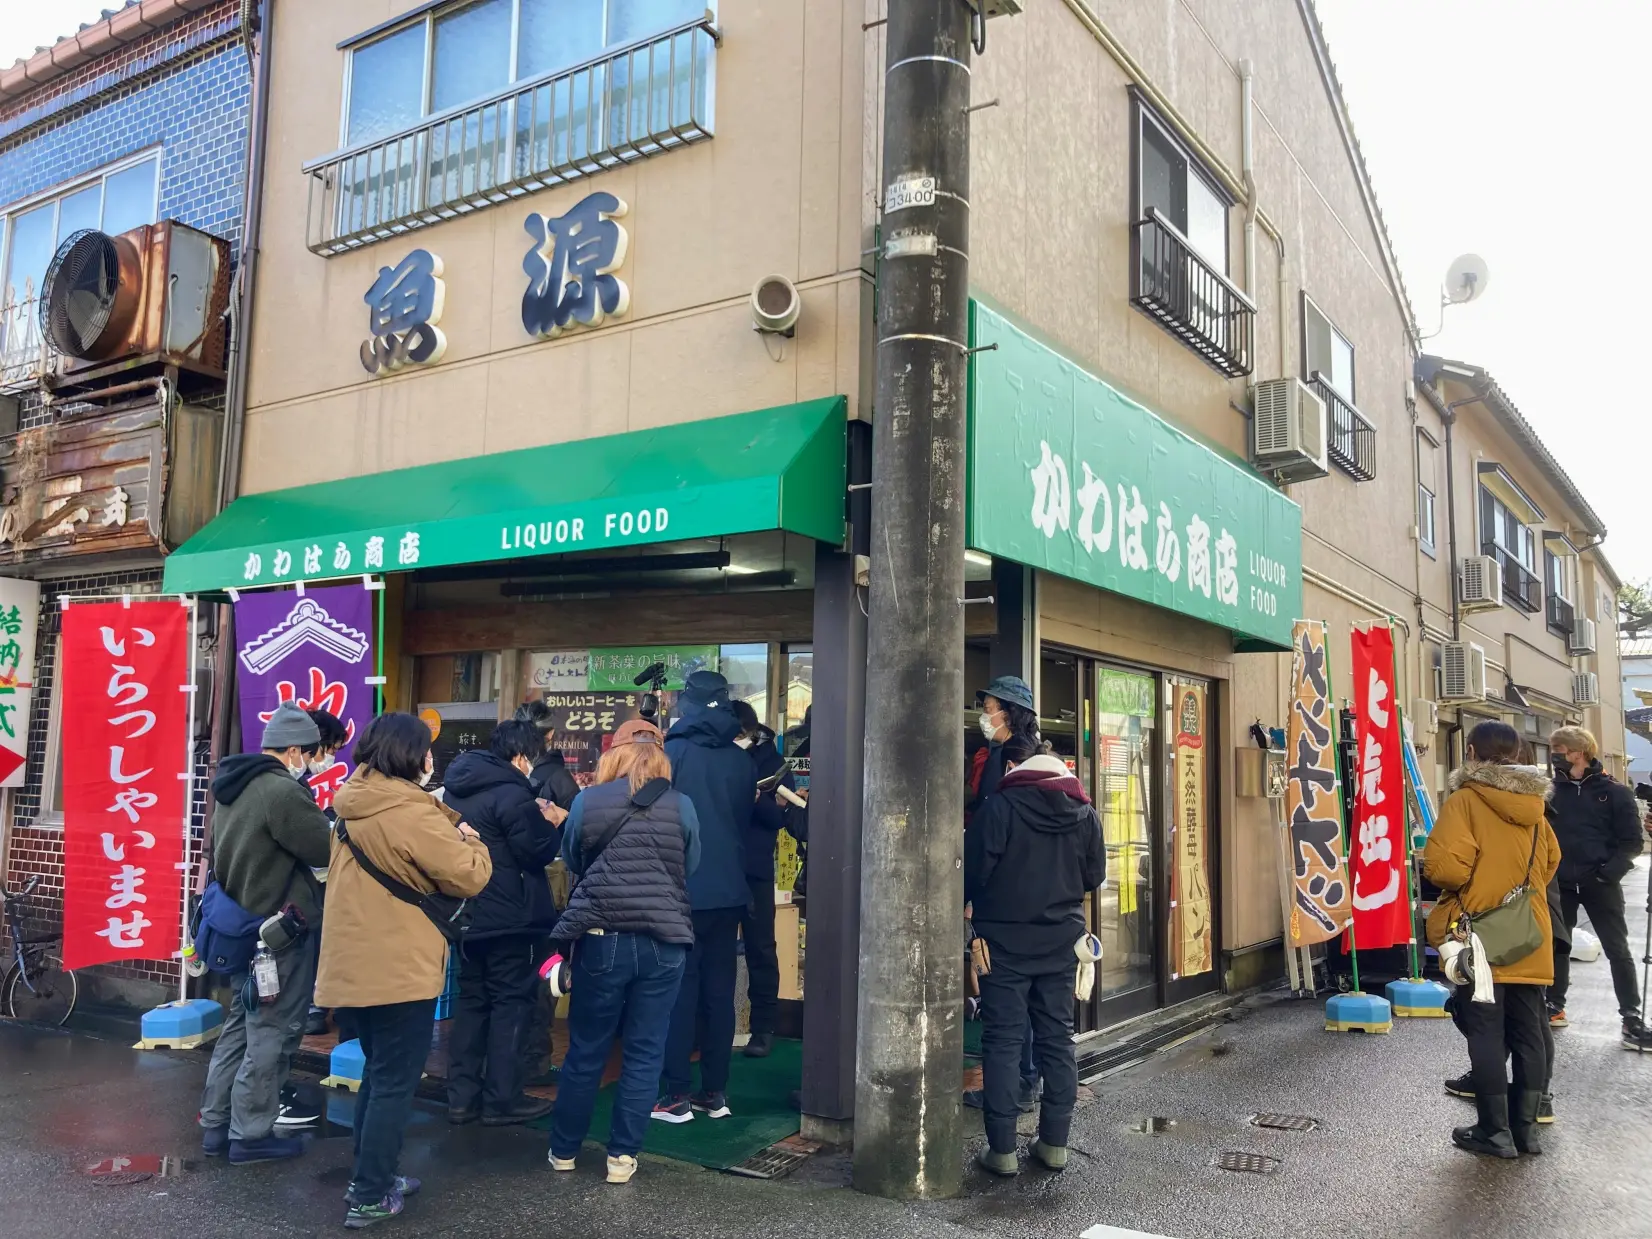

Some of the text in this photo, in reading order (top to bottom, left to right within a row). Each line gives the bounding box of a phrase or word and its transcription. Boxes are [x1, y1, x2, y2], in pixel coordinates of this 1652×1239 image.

[360, 191, 630, 376] 魚源
[502, 507, 669, 550] LIQUOR FOOD
[1031, 440, 1238, 606] かわはら商店
[244, 532, 420, 580] かわはら商店
[1250, 550, 1286, 588] LIQUOR
[1250, 585, 1277, 617] FOOD
[546, 695, 635, 707] おいしいコーヒーを
[565, 711, 615, 731] どうぞ
[553, 740, 589, 750] PREMIUM
[1184, 754, 1204, 940] 天然酵母パン
